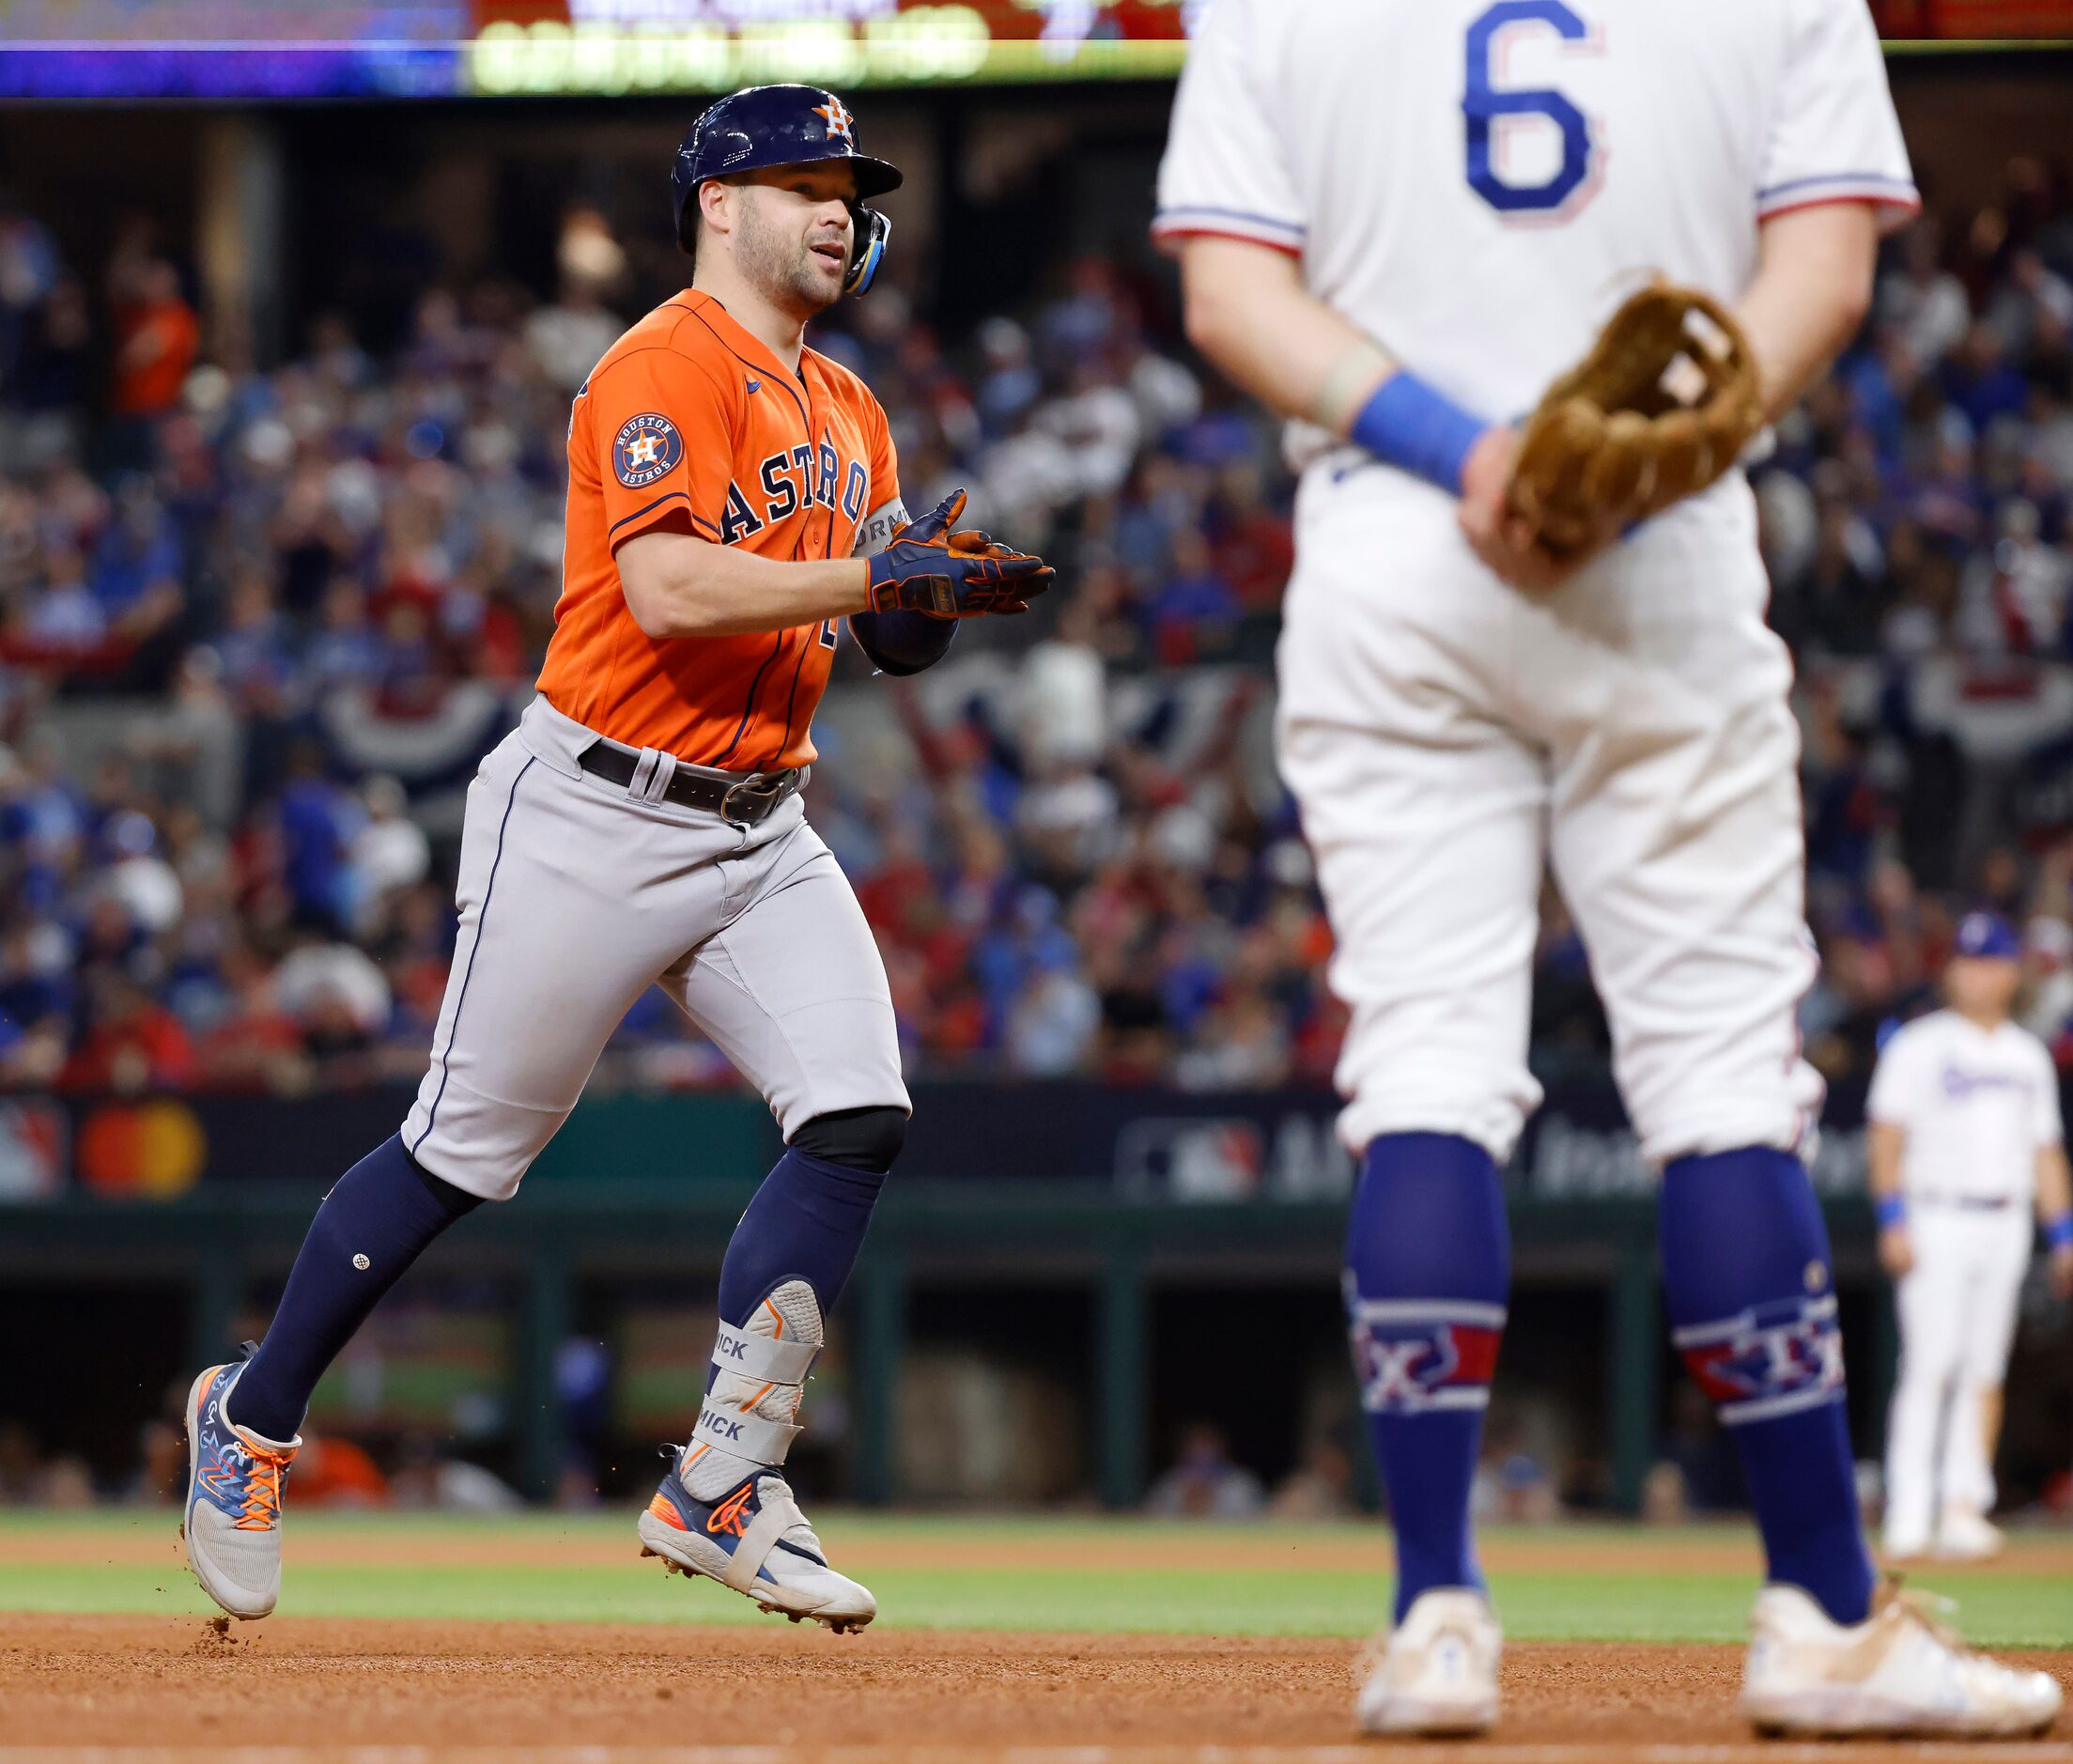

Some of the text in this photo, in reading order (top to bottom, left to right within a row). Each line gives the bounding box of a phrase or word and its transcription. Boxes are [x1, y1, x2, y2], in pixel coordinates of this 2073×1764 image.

[821, 101, 852, 138] H
[1462, 0, 1610, 228] 6
[617, 417, 673, 446] HOUSTON
[629, 435, 657, 467] H
[622, 460, 671, 484] ASTROS
[720, 441, 868, 545] ASTRO
[716, 1332, 749, 1361] ICK
